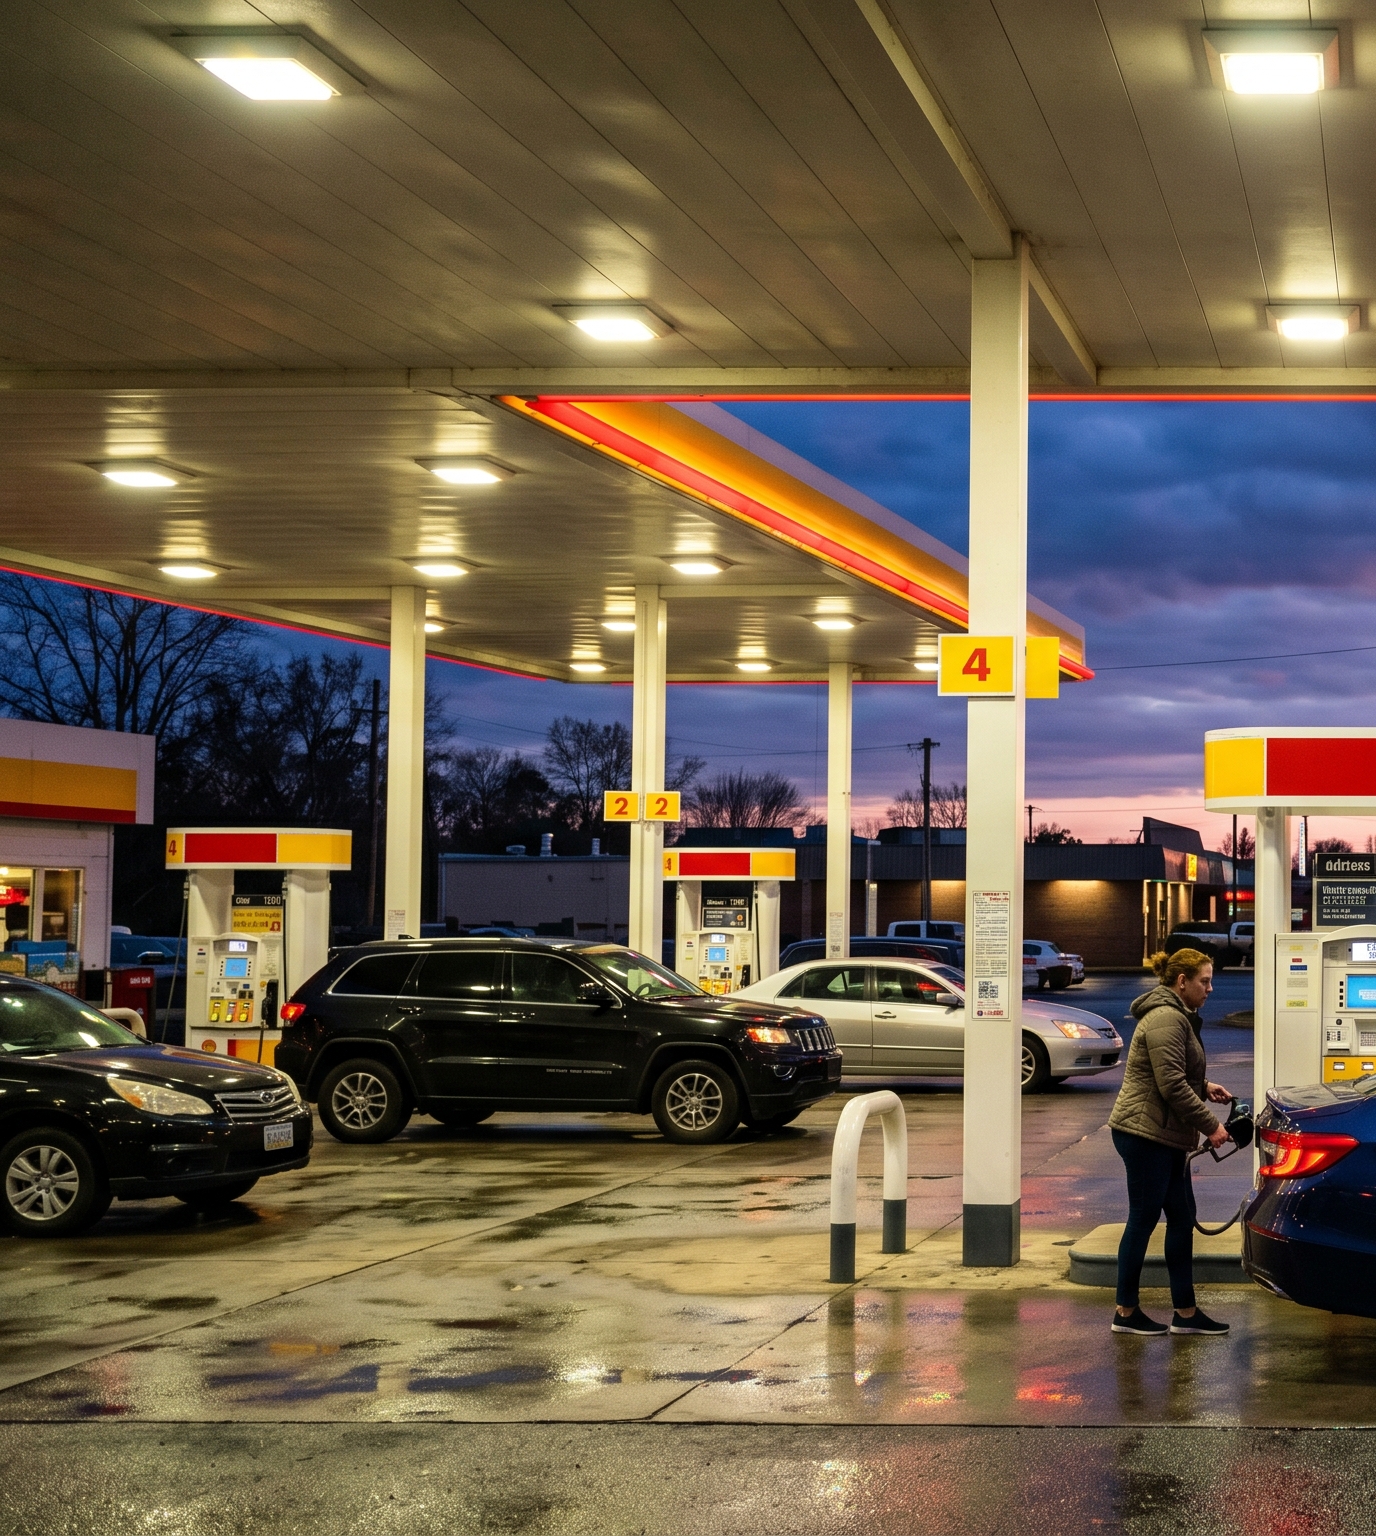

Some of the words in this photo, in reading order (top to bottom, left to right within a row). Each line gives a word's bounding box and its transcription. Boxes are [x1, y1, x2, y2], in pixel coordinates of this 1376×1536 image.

[962, 648, 991, 682] 4
[614, 797, 629, 816] 2
[655, 797, 668, 816] 2
[168, 839, 177, 856] 4
